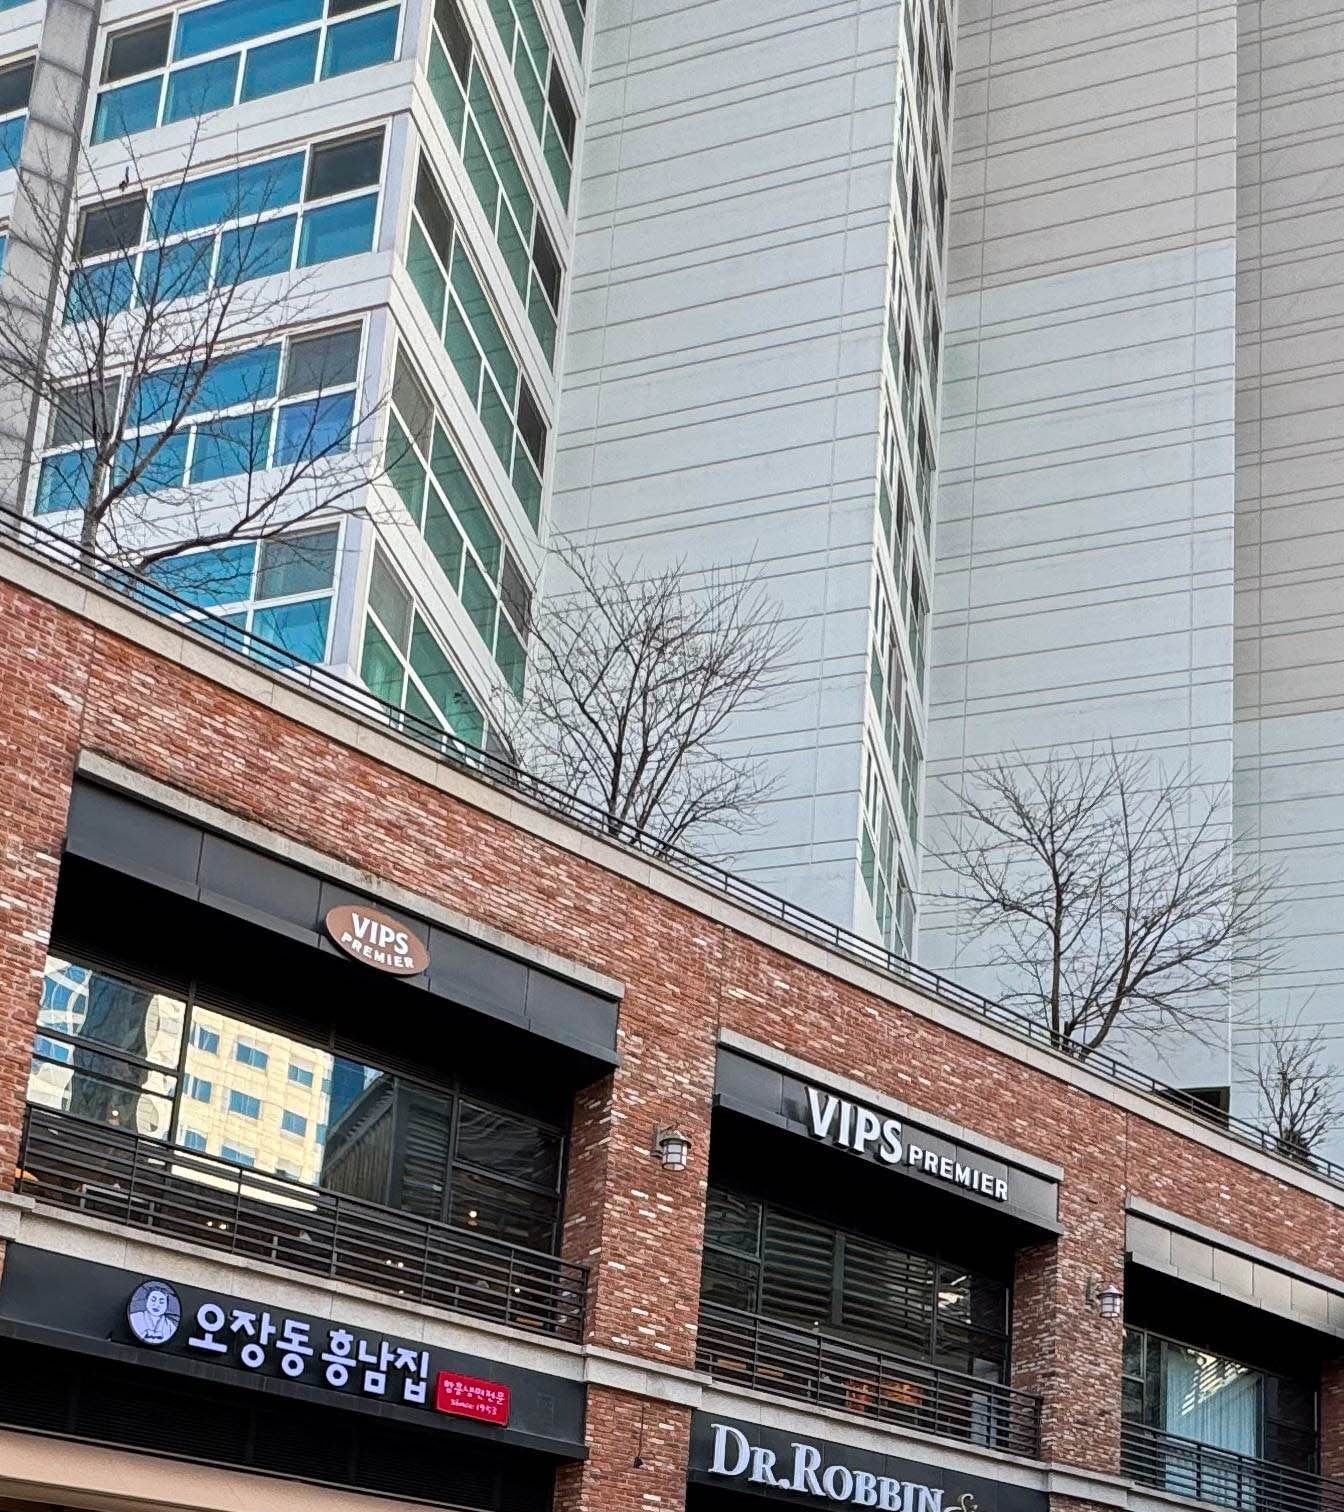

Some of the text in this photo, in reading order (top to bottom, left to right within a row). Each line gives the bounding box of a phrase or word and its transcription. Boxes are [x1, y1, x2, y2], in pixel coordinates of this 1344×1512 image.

[341, 931, 415, 968] PREMIER
[351, 912, 409, 955] VIPS
[806, 1086, 1008, 1200] VIPS PREMIER
[188, 1303, 430, 1404] 오장동 흥남집
[476, 1402, 497, 1416] 1953
